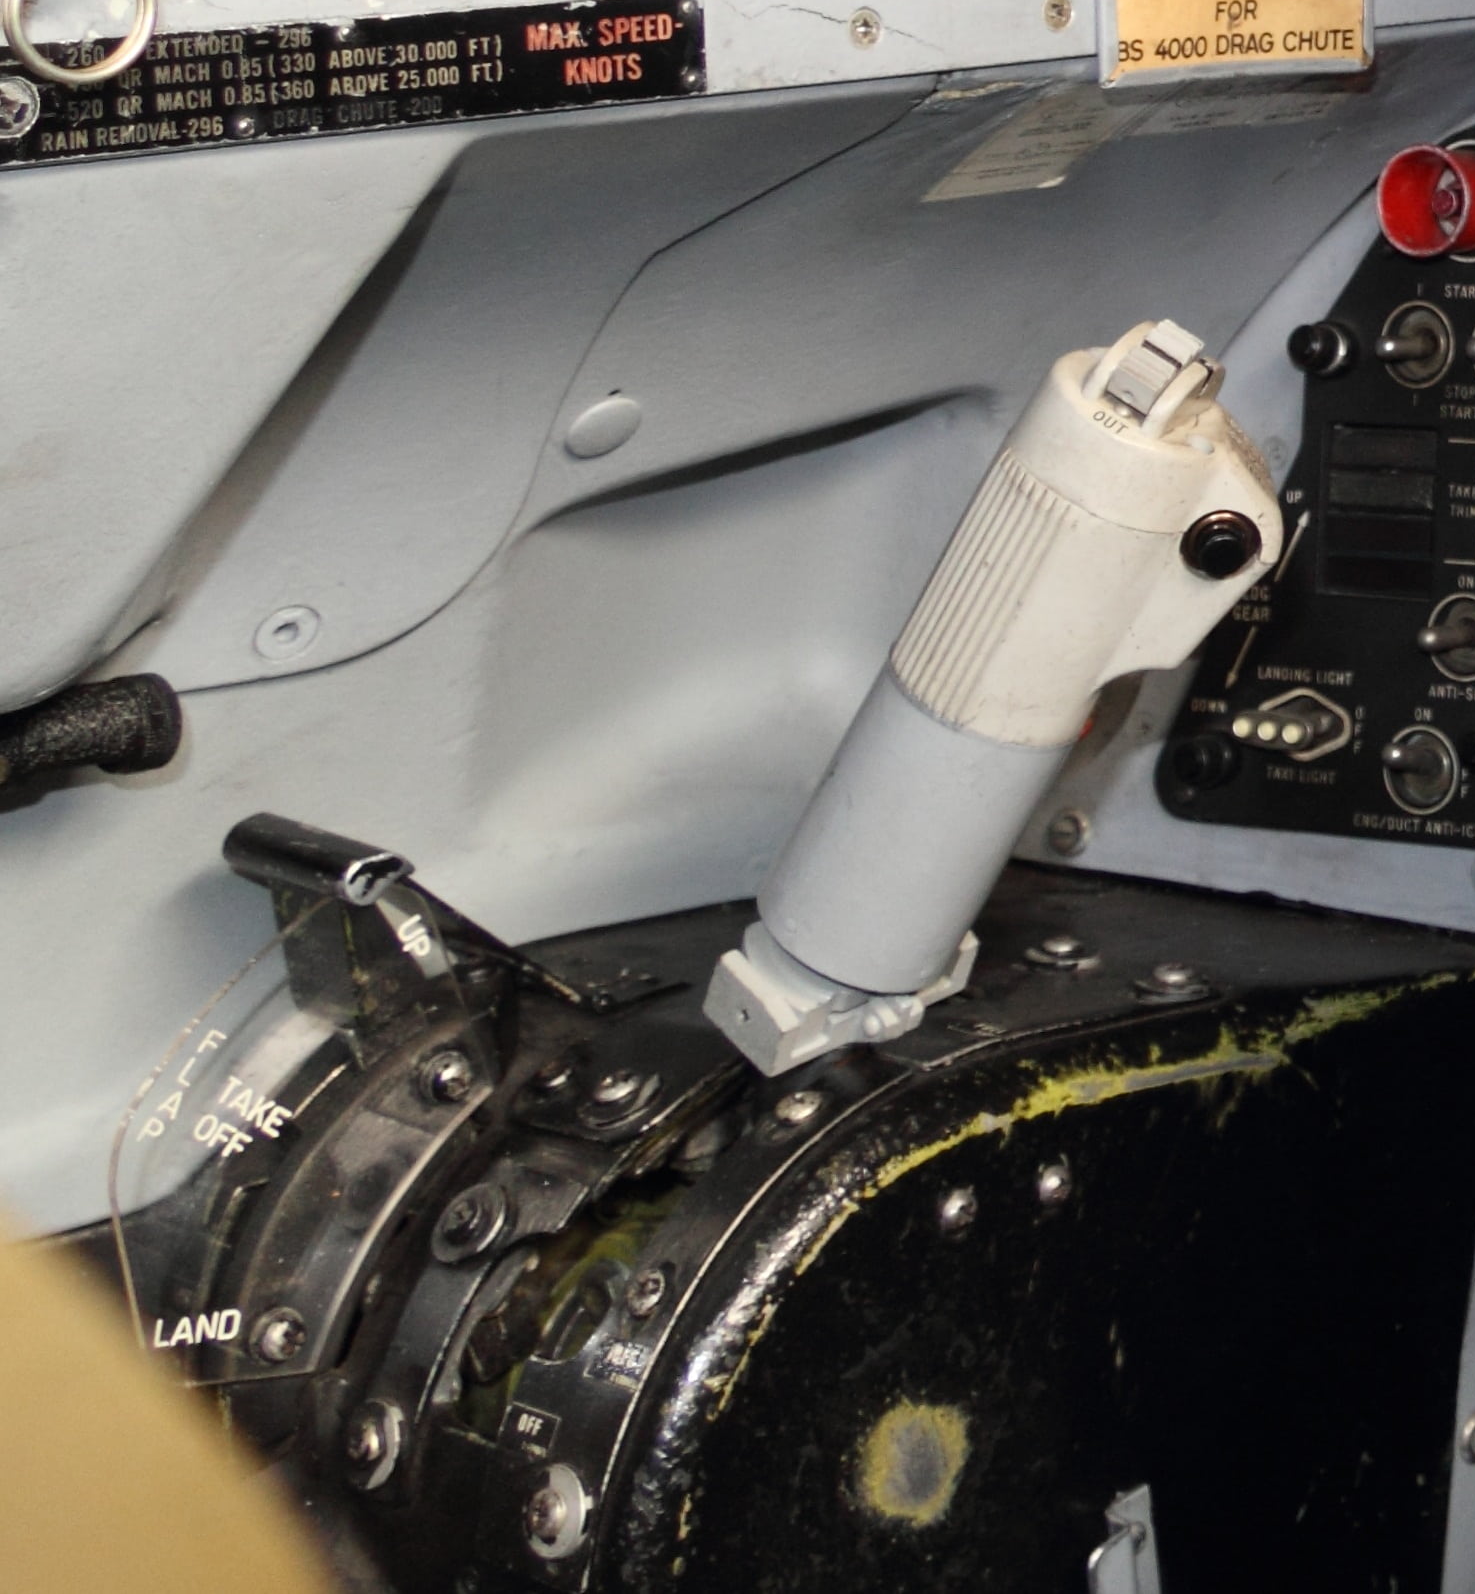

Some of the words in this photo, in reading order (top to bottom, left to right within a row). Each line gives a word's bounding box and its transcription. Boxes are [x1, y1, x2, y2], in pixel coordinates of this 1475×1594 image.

[1215, 0, 1258, 21] FOR
[1155, 36, 1208, 60] 4000
[1216, 32, 1274, 55] DRAG
[1283, 30, 1354, 51] CHUTE
[156, 61, 210, 84] MACH
[329, 48, 387, 70] ABOVE
[564, 55, 642, 85] KNOTS
[157, 88, 212, 111] MACH
[330, 74, 389, 97] ABOVE
[398, 66, 459, 89] 25.000
[42, 132, 88, 152] RAIN
[215, 1077, 291, 1138] TAKE
[192, 1113, 252, 1158] OFF
[153, 1308, 241, 1348] LAND
[516, 1413, 544, 1436] OFF
